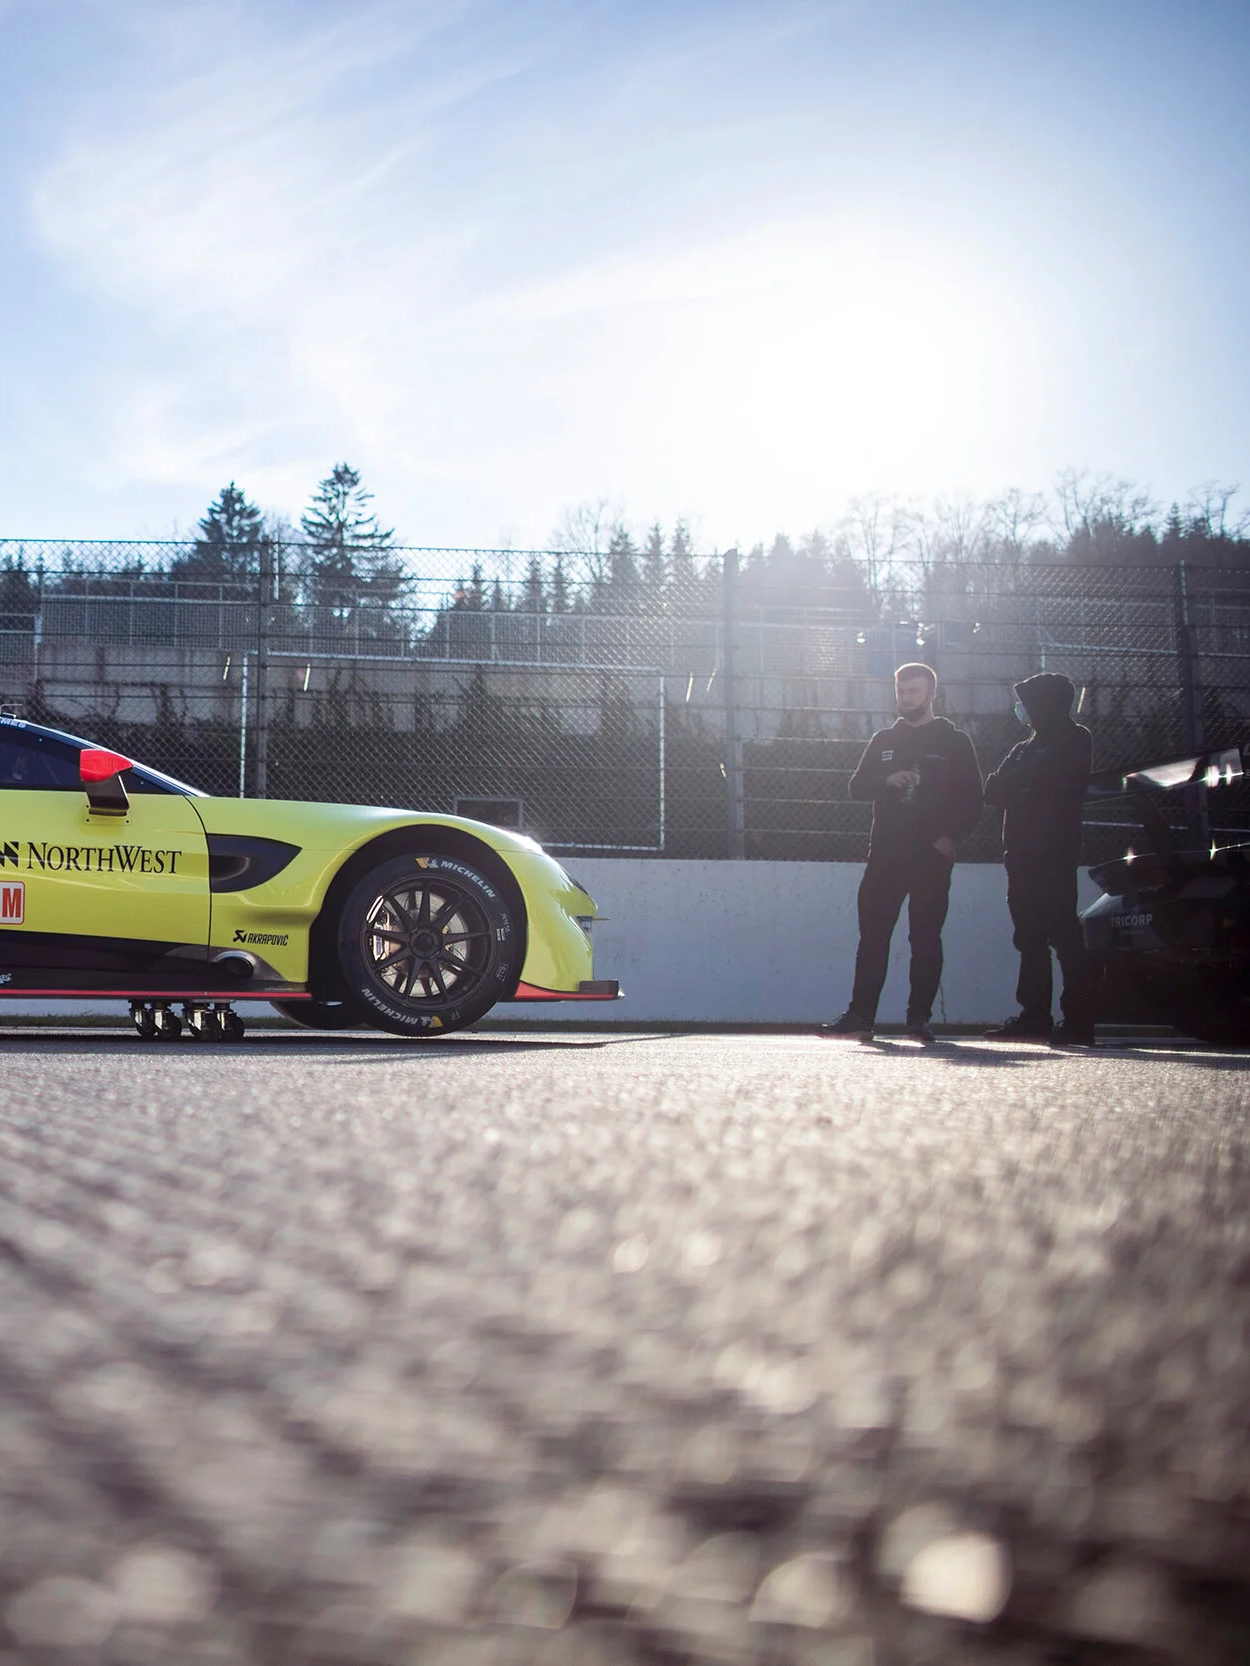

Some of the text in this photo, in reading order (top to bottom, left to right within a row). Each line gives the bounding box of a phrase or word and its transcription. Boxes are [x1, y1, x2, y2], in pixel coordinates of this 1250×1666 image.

[440, 860, 496, 899] MICHELIN
[1109, 913, 1153, 928] TRICORP
[361, 987, 419, 1025] MICHELIN
